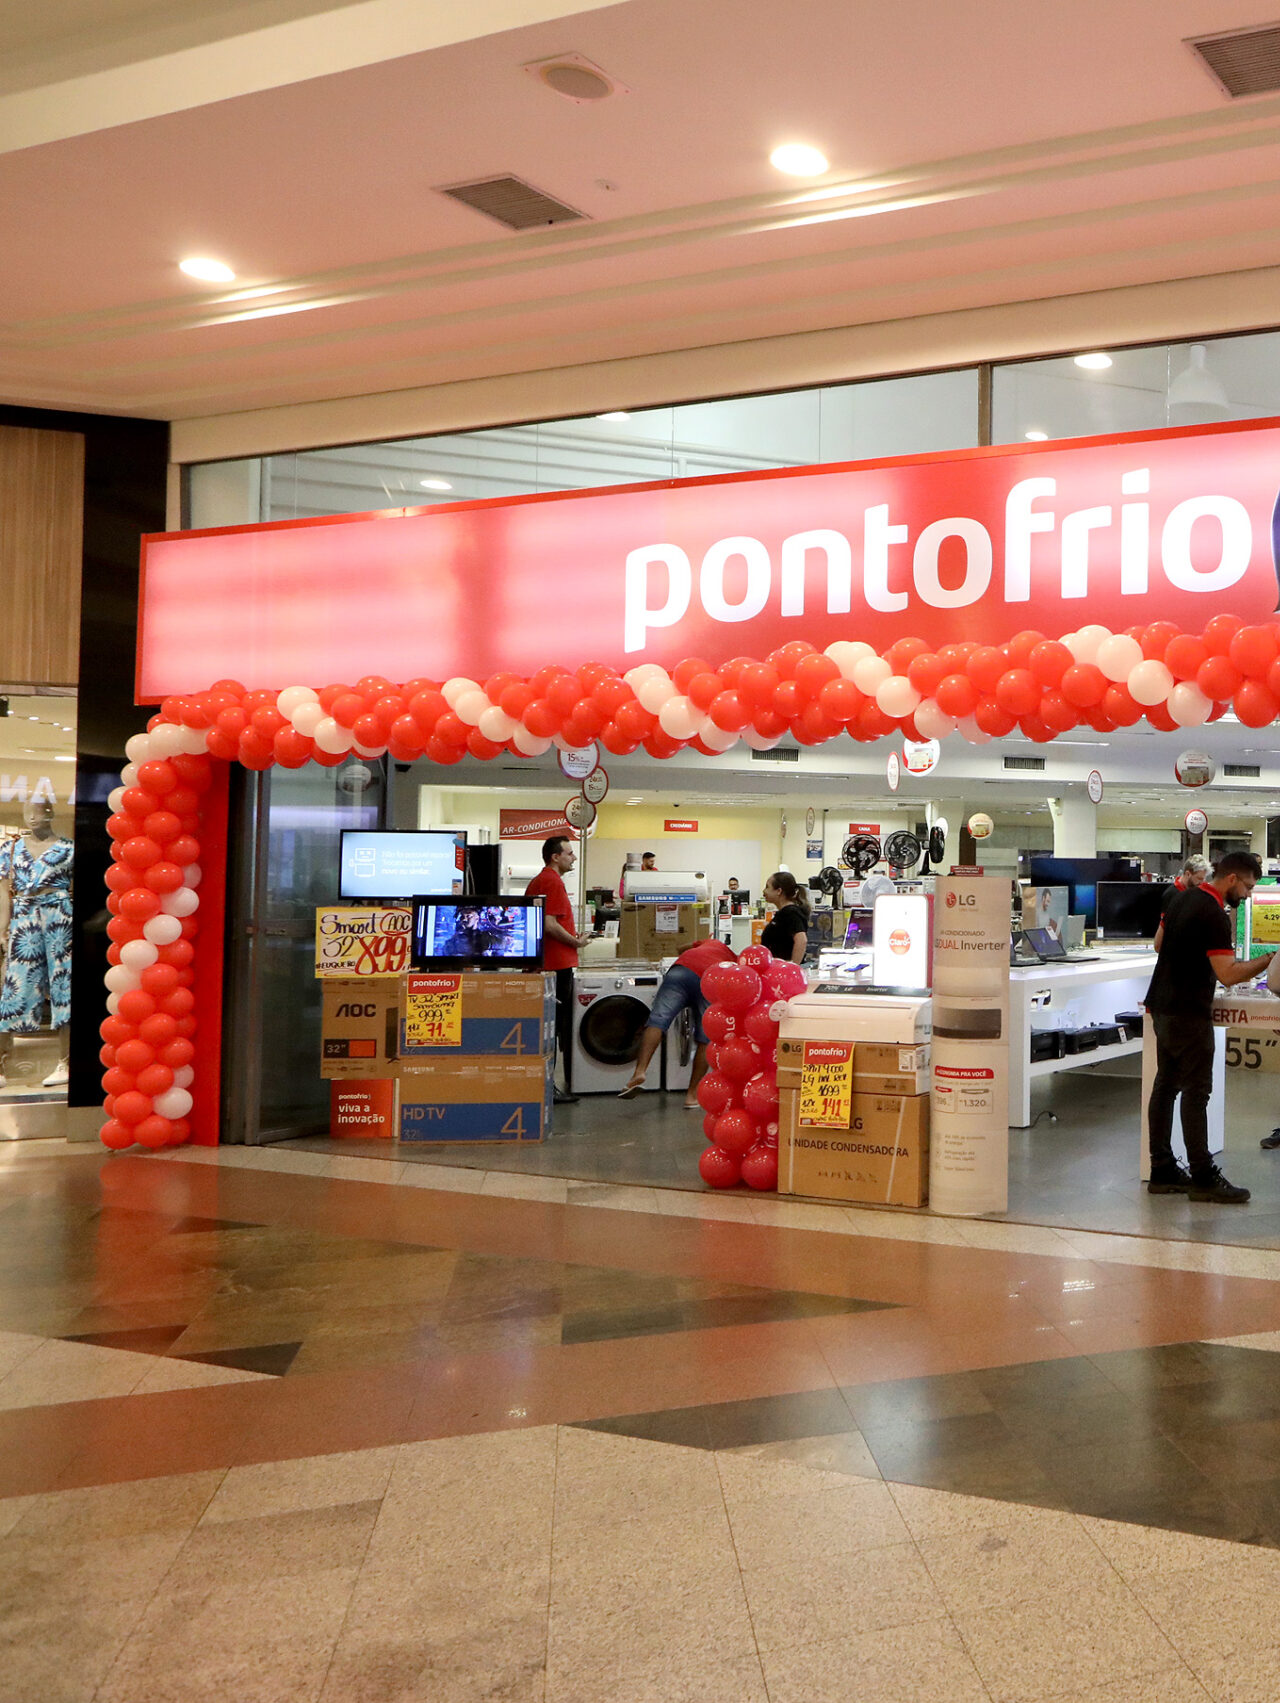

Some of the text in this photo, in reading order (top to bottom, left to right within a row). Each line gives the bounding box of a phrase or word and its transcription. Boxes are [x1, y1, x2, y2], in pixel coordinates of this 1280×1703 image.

[624, 468, 1253, 654] pontofrio
[502, 818, 568, 834] AR-CONDICIONA
[959, 894, 976, 906] LG
[388, 914, 411, 932] AOC
[961, 940, 1006, 951] Inverter
[748, 957, 760, 965] LG
[413, 979, 452, 988] pontofrio
[336, 1004, 376, 1018] AOC
[1213, 1008, 1249, 1024] ERTA
[726, 1016, 735, 1031] LG
[500, 1021, 526, 1056] 4
[327, 1044, 346, 1054] 32"
[792, 1045, 802, 1053] LG
[809, 1047, 844, 1057] pontofrio
[1225, 1037, 1278, 1070] 55"
[338, 1103, 371, 1113] viva a
[338, 1114, 385, 1125] inovação
[500, 1106, 527, 1141] 4
[831, 1141, 909, 1157] CONDENSADORA
